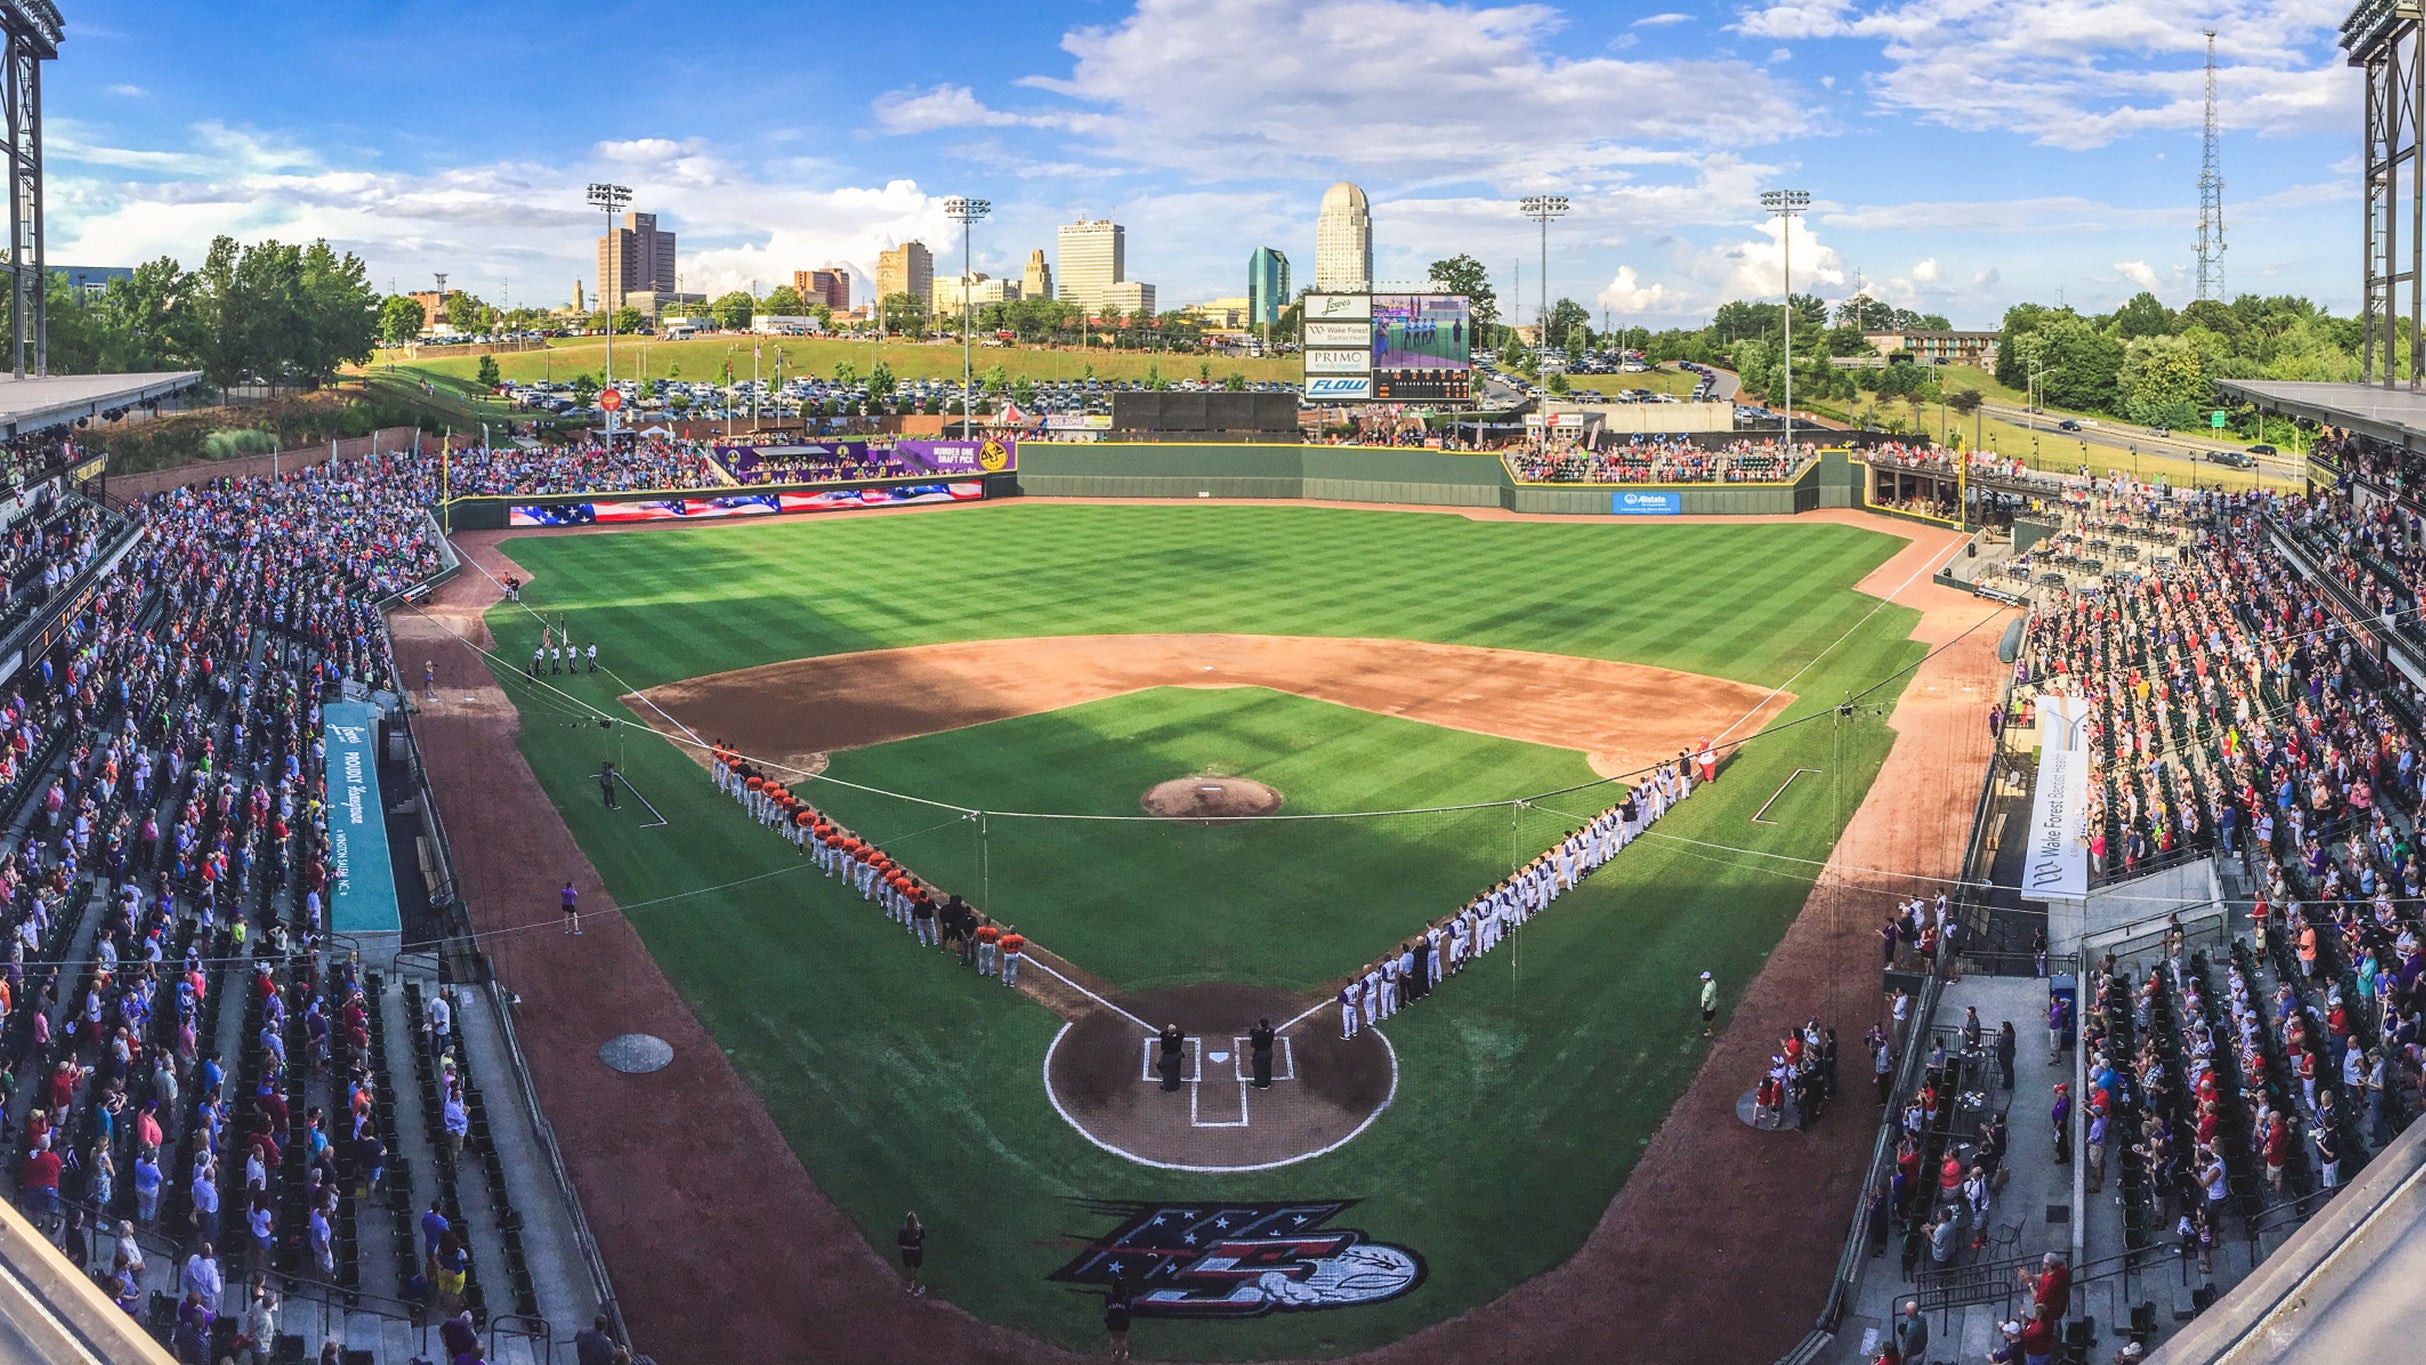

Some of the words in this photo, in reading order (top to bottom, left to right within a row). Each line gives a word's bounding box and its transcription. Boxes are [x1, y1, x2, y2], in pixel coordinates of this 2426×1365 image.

[1321, 297, 1351, 316] Lowes
[1315, 352, 1362, 363] PRIMO
[1312, 380, 1369, 390] FLOW
[933, 447, 960, 455] NUMBER
[961, 447, 974, 456] ONE
[938, 455, 958, 463] DRAFT
[959, 455, 974, 463] PICK
[344, 751, 363, 784] PROUDLY
[2043, 800, 2064, 829] Forest
[335, 832, 348, 859] WINSTON
[2040, 830, 2061, 858] Wake
